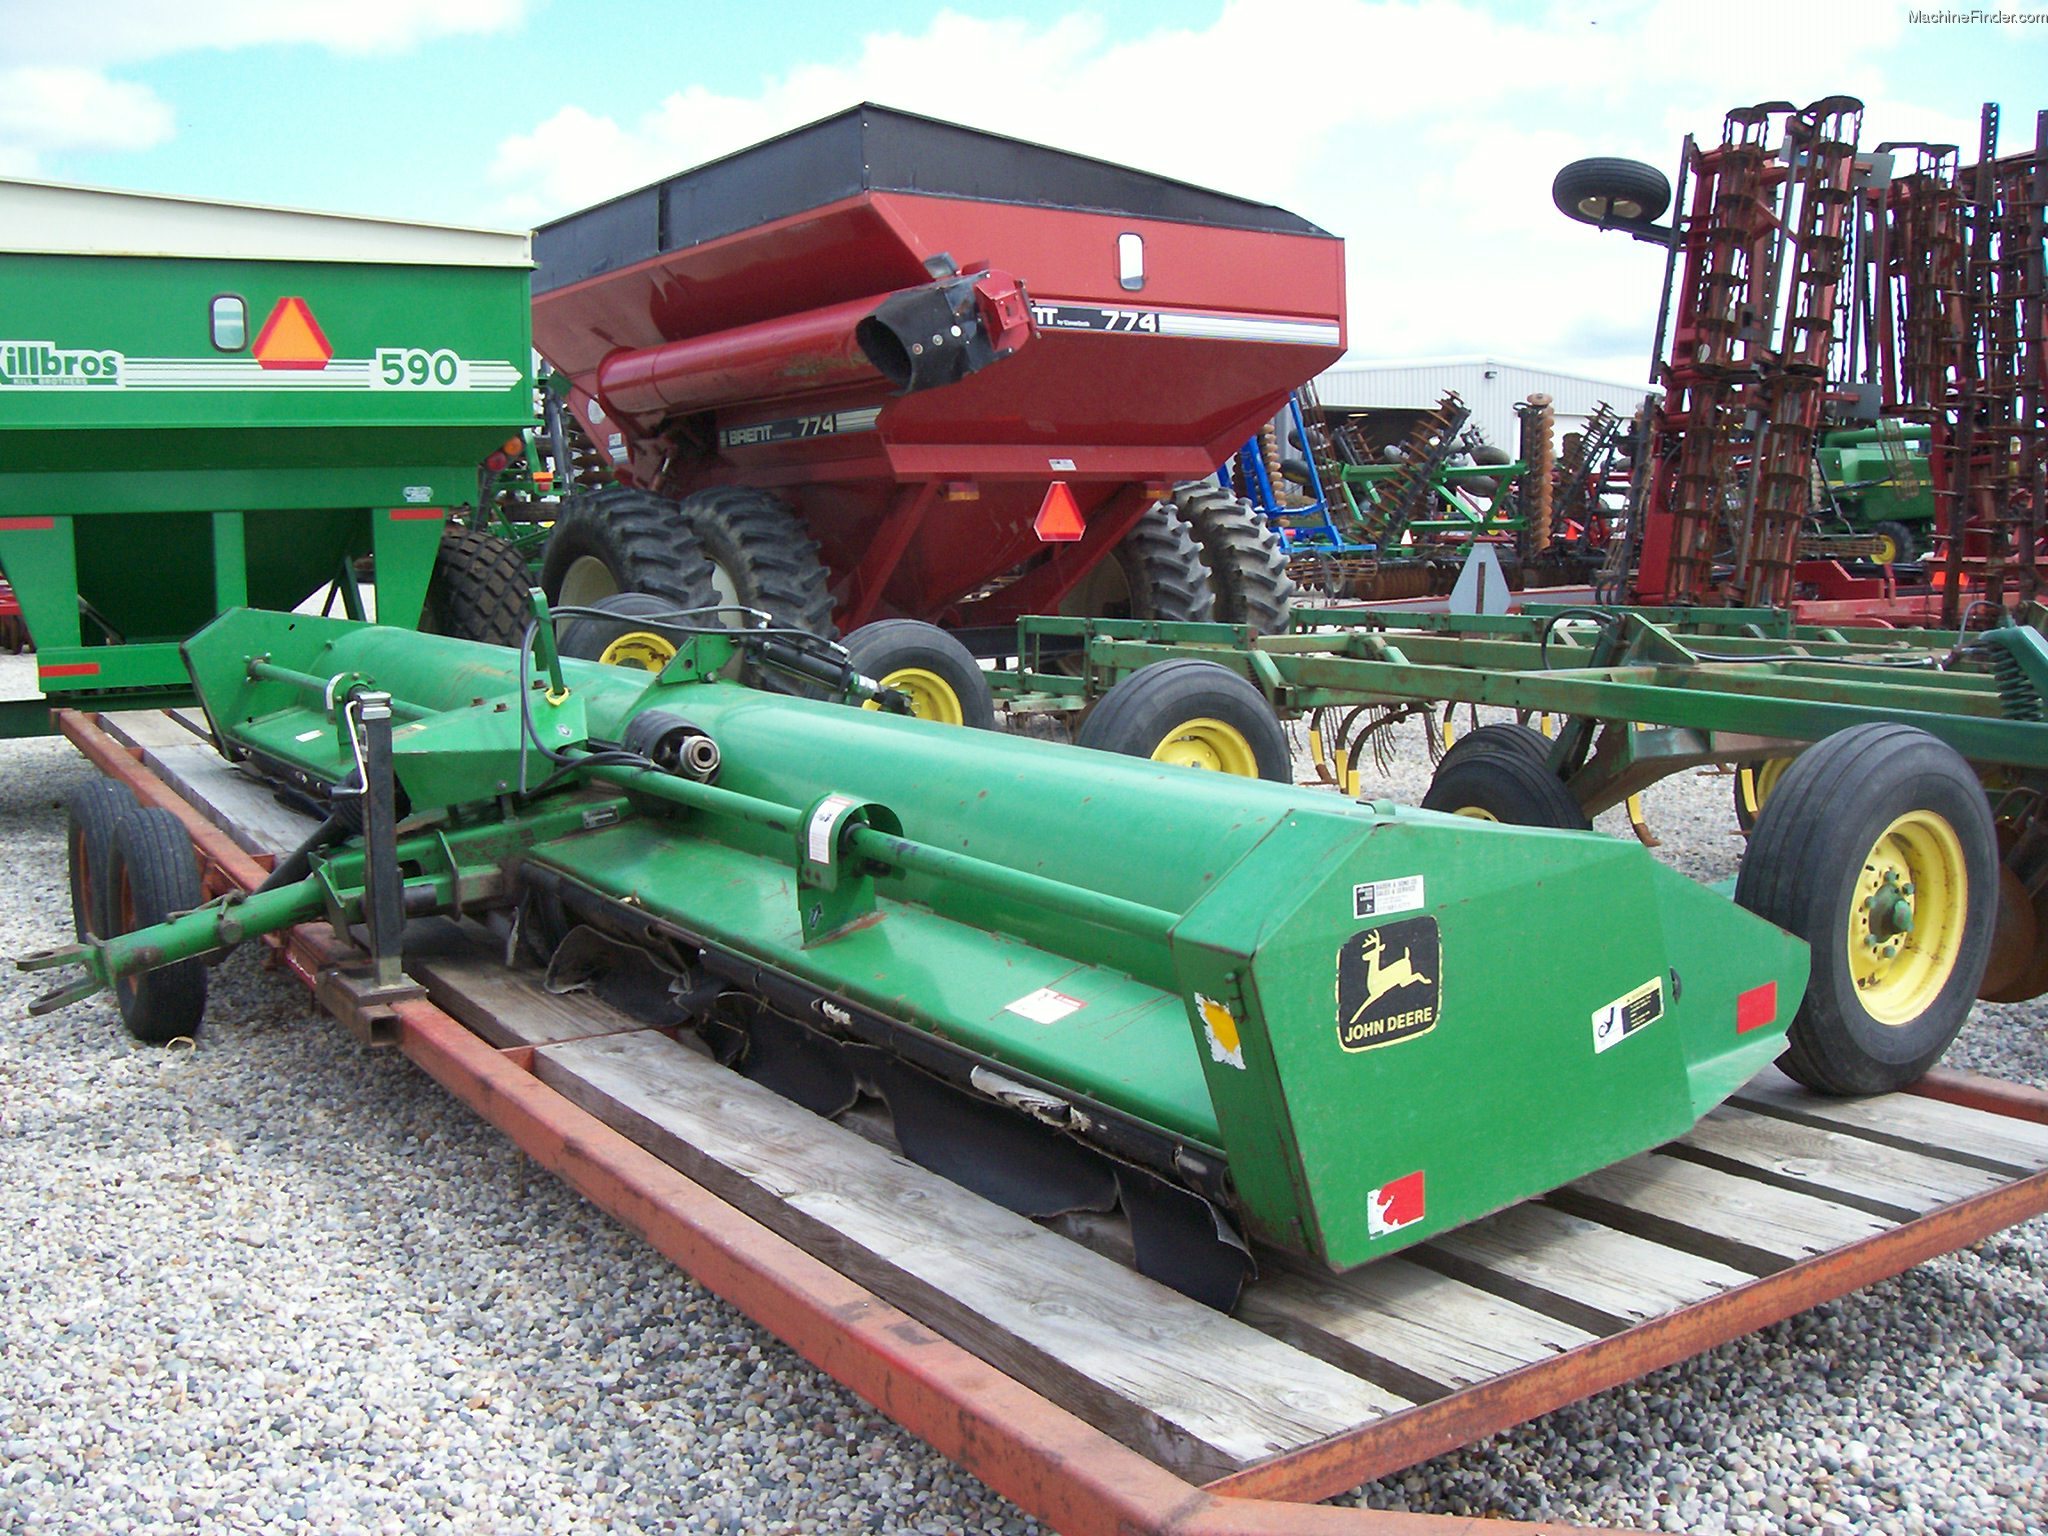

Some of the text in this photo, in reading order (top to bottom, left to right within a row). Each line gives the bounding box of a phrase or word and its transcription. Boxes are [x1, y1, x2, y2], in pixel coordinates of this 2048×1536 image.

[1101, 310, 1157, 333] 774
[382, 353, 457, 386] 590
[729, 415, 833, 444] BRENT 774
[1345, 1008, 1432, 1042] JOHN DEERE
